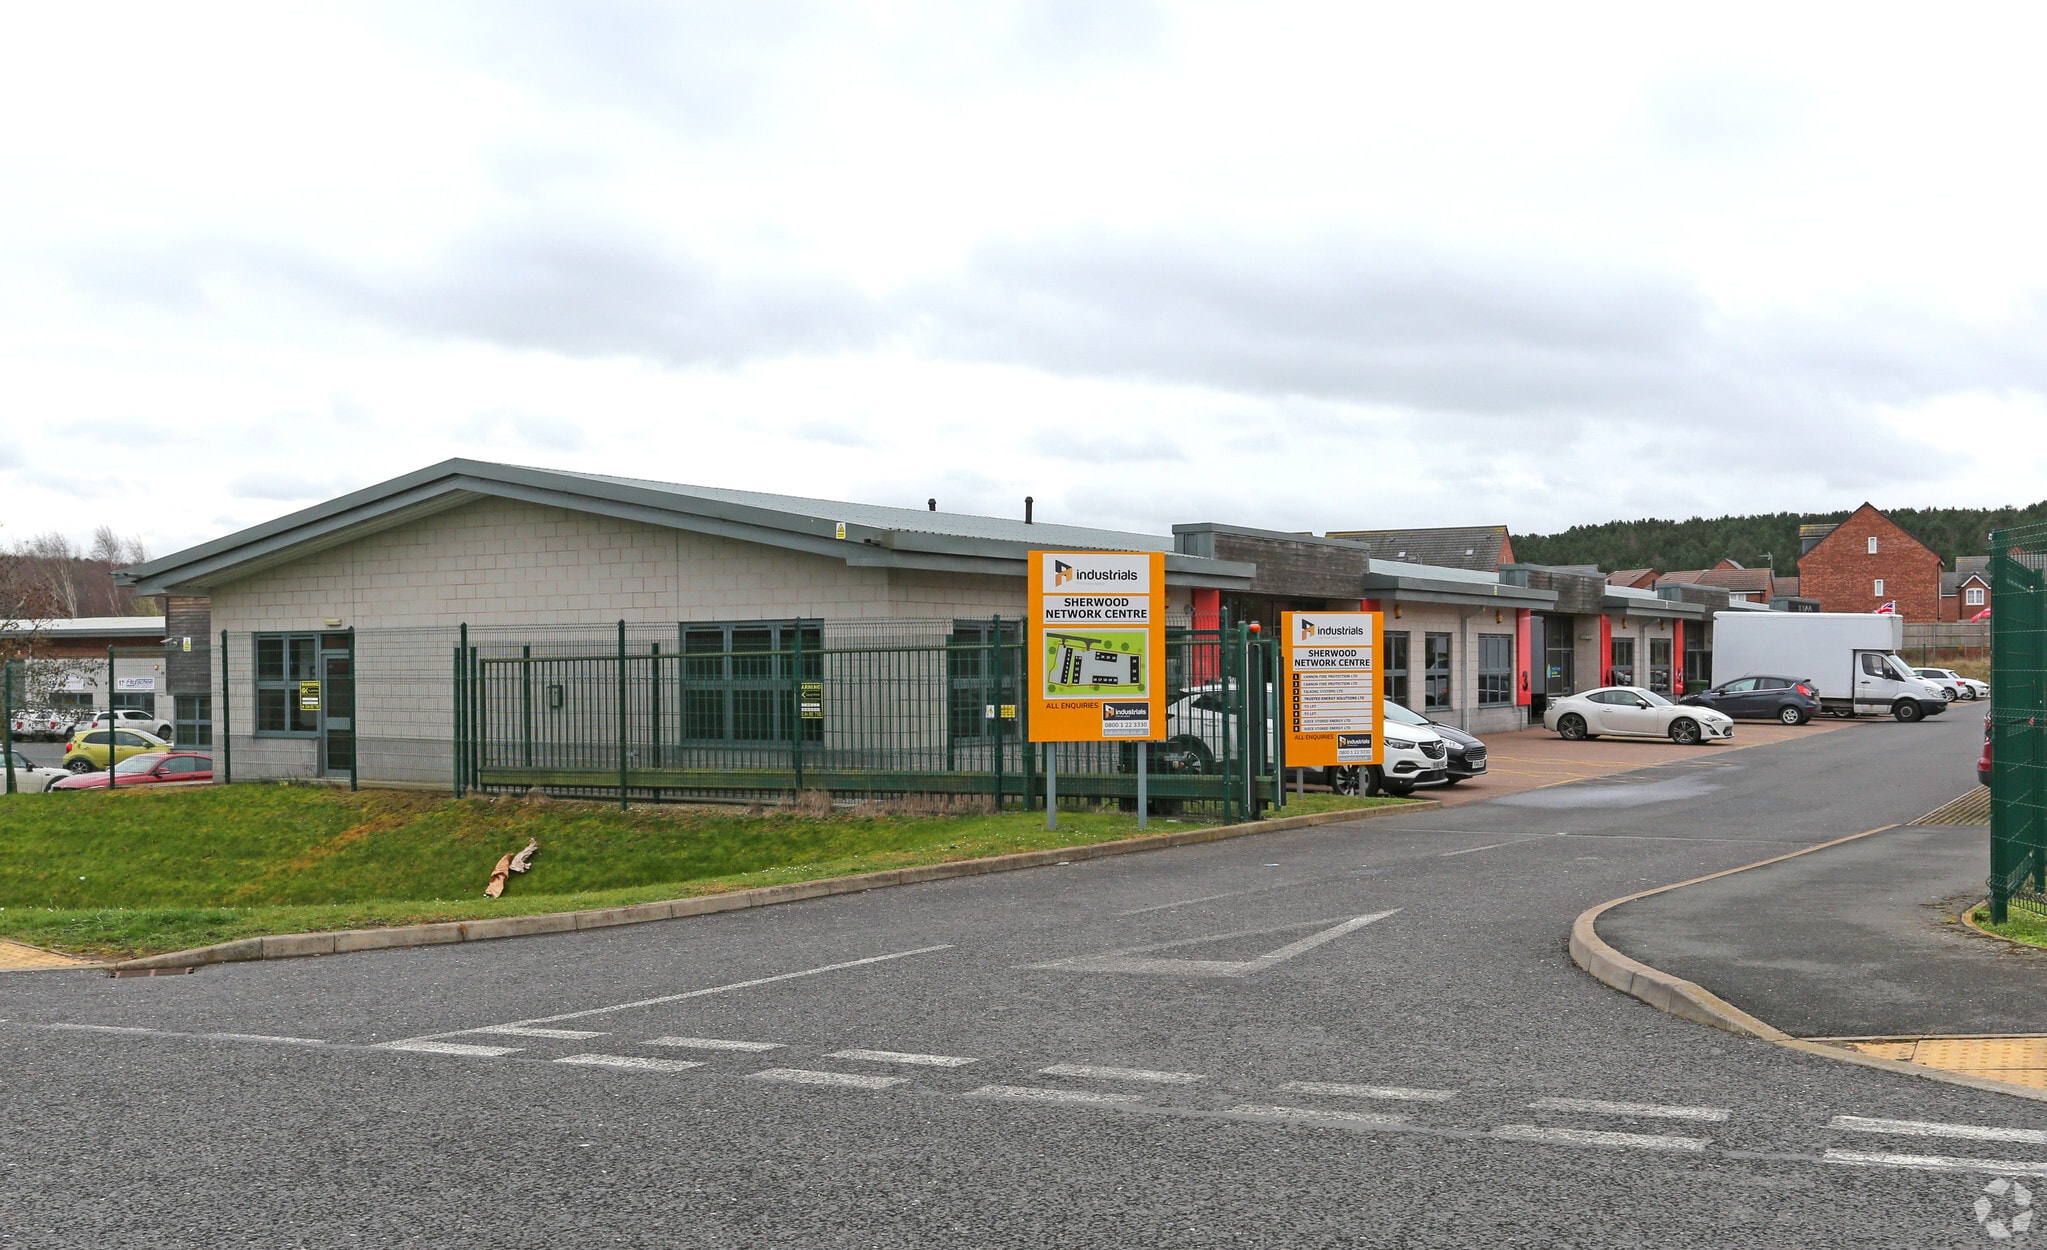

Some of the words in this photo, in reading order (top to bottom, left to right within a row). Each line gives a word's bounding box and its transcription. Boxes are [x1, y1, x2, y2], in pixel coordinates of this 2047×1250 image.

[1076, 570, 1137, 580] industrials
[1064, 598, 1128, 606] SHERWOOD
[1046, 610, 1101, 618] NETWORK
[1105, 609, 1147, 618] CENTRE
[1318, 626, 1363, 635] industrials
